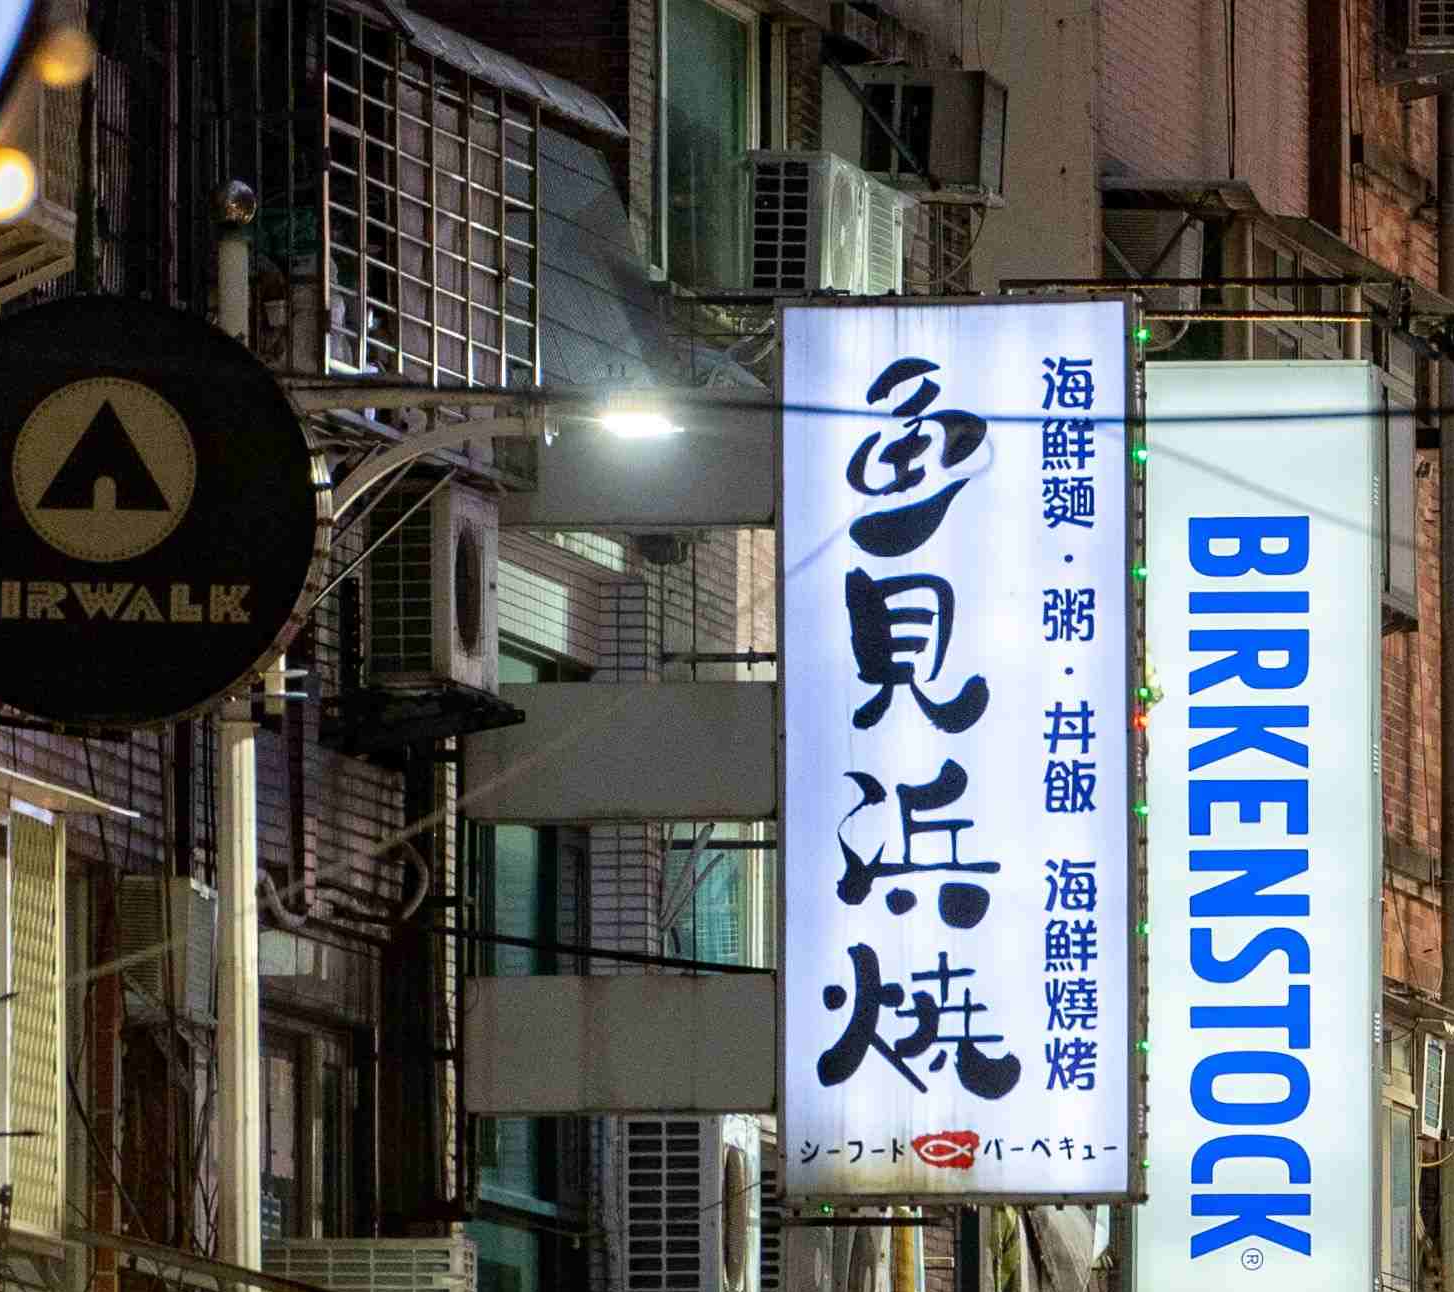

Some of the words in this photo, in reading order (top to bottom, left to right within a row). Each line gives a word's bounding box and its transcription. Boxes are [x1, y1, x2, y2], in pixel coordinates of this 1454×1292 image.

[1043, 858, 1098, 1091] 海鮮燒烤
[1188, 516, 1311, 1259] BIRKENSTOCK
[800, 1138, 906, 1165] シーフード
[983, 1135, 1118, 1162] バーベキュー
